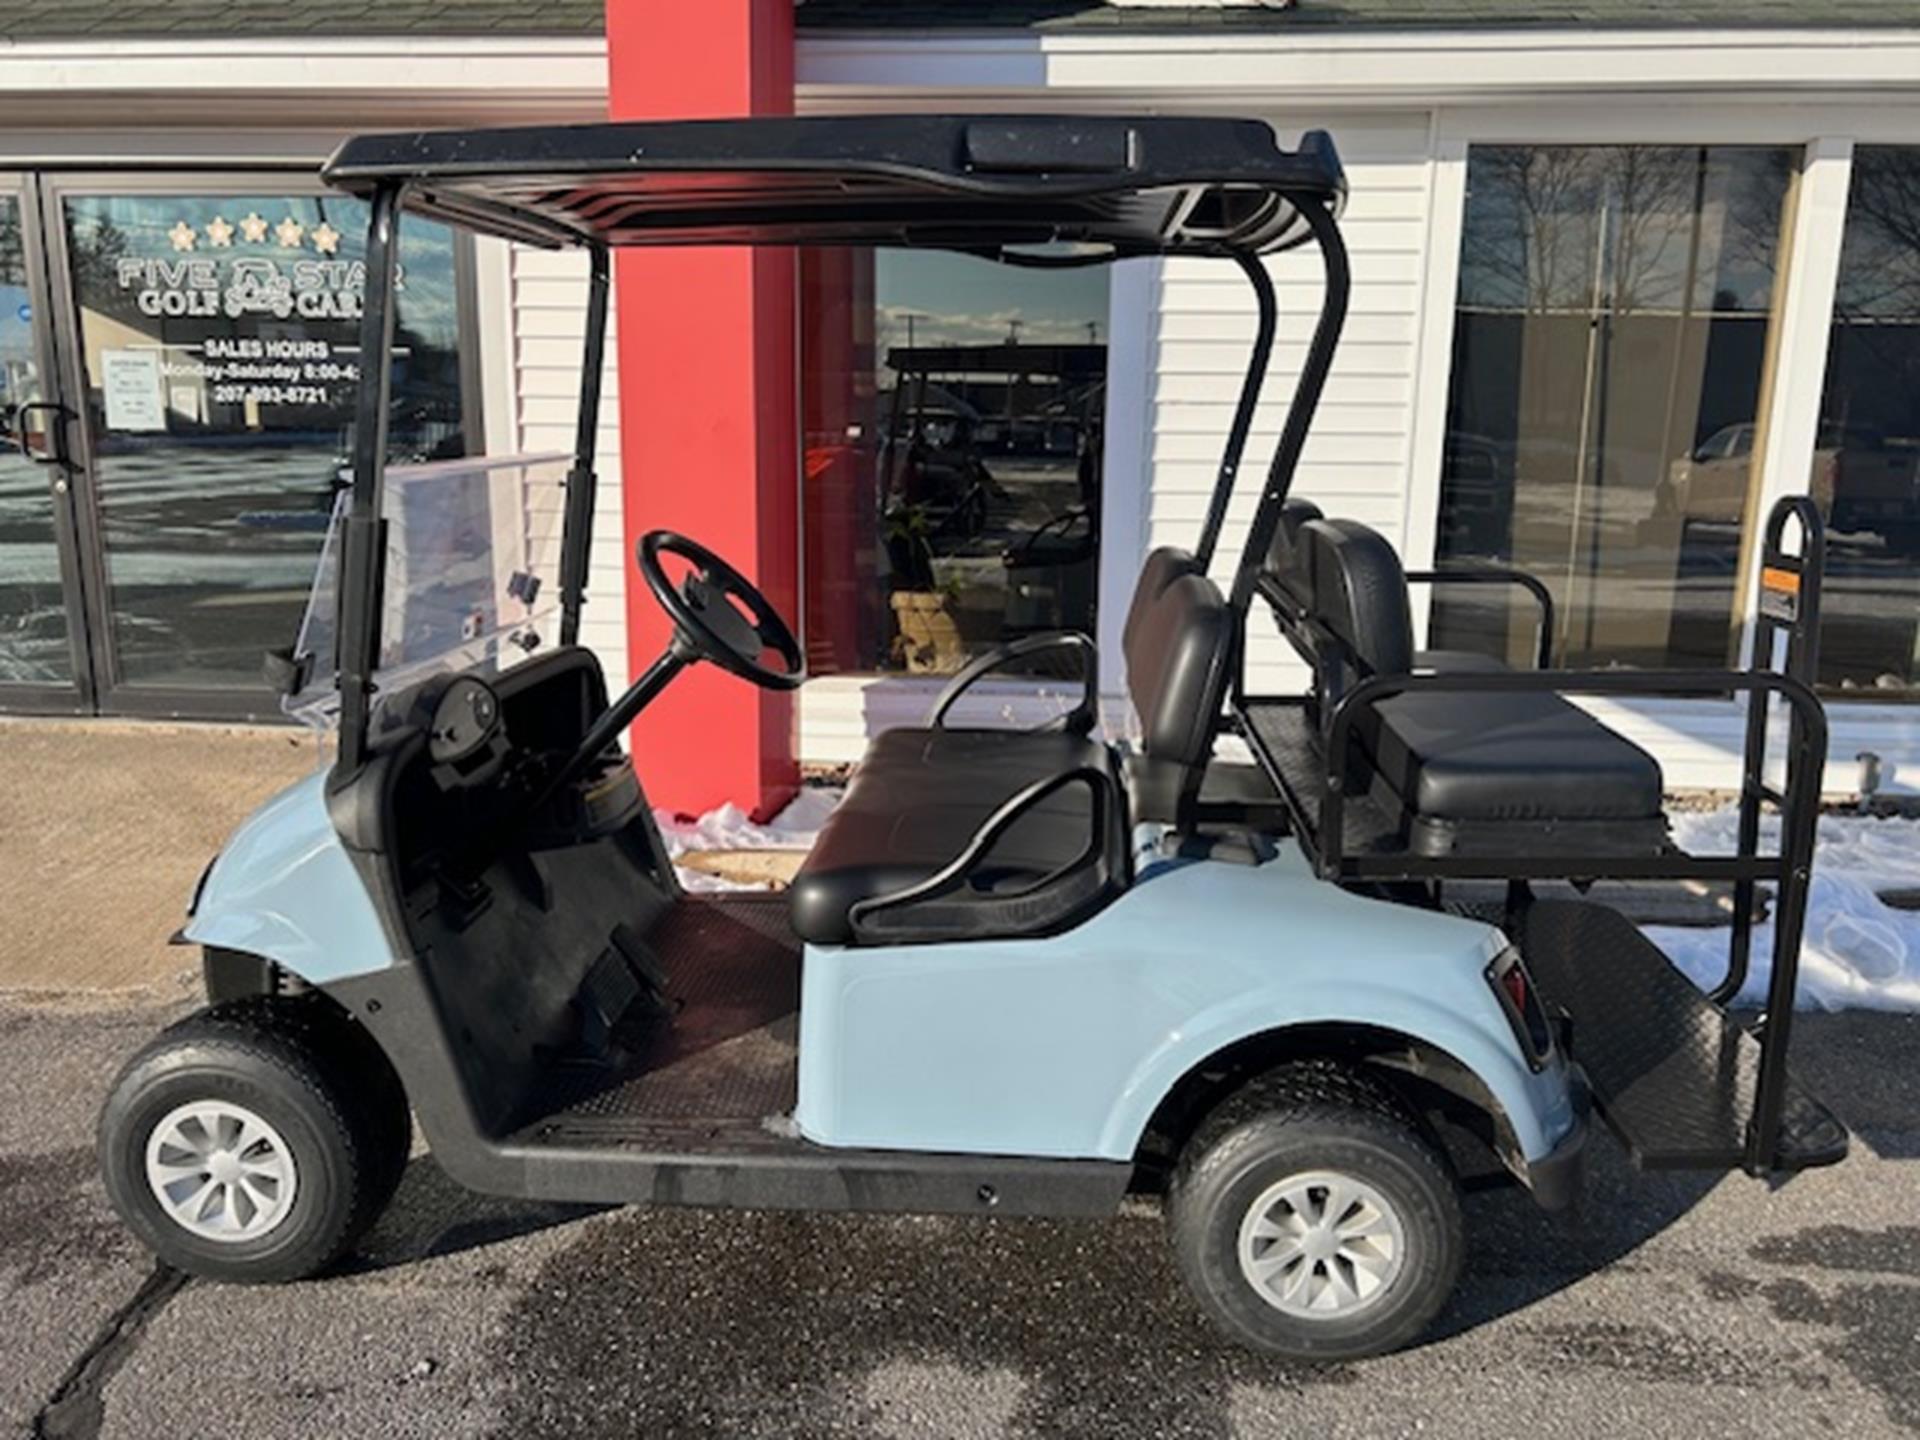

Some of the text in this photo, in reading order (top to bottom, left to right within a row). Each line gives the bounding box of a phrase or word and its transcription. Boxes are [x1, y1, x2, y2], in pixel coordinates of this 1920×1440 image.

[116, 259, 220, 287] FIVE
[138, 289, 219, 315] GOLF
[205, 340, 328, 358] SALES HOURS
[159, 362, 360, 382] Monday-Saturday 8:00-4:
